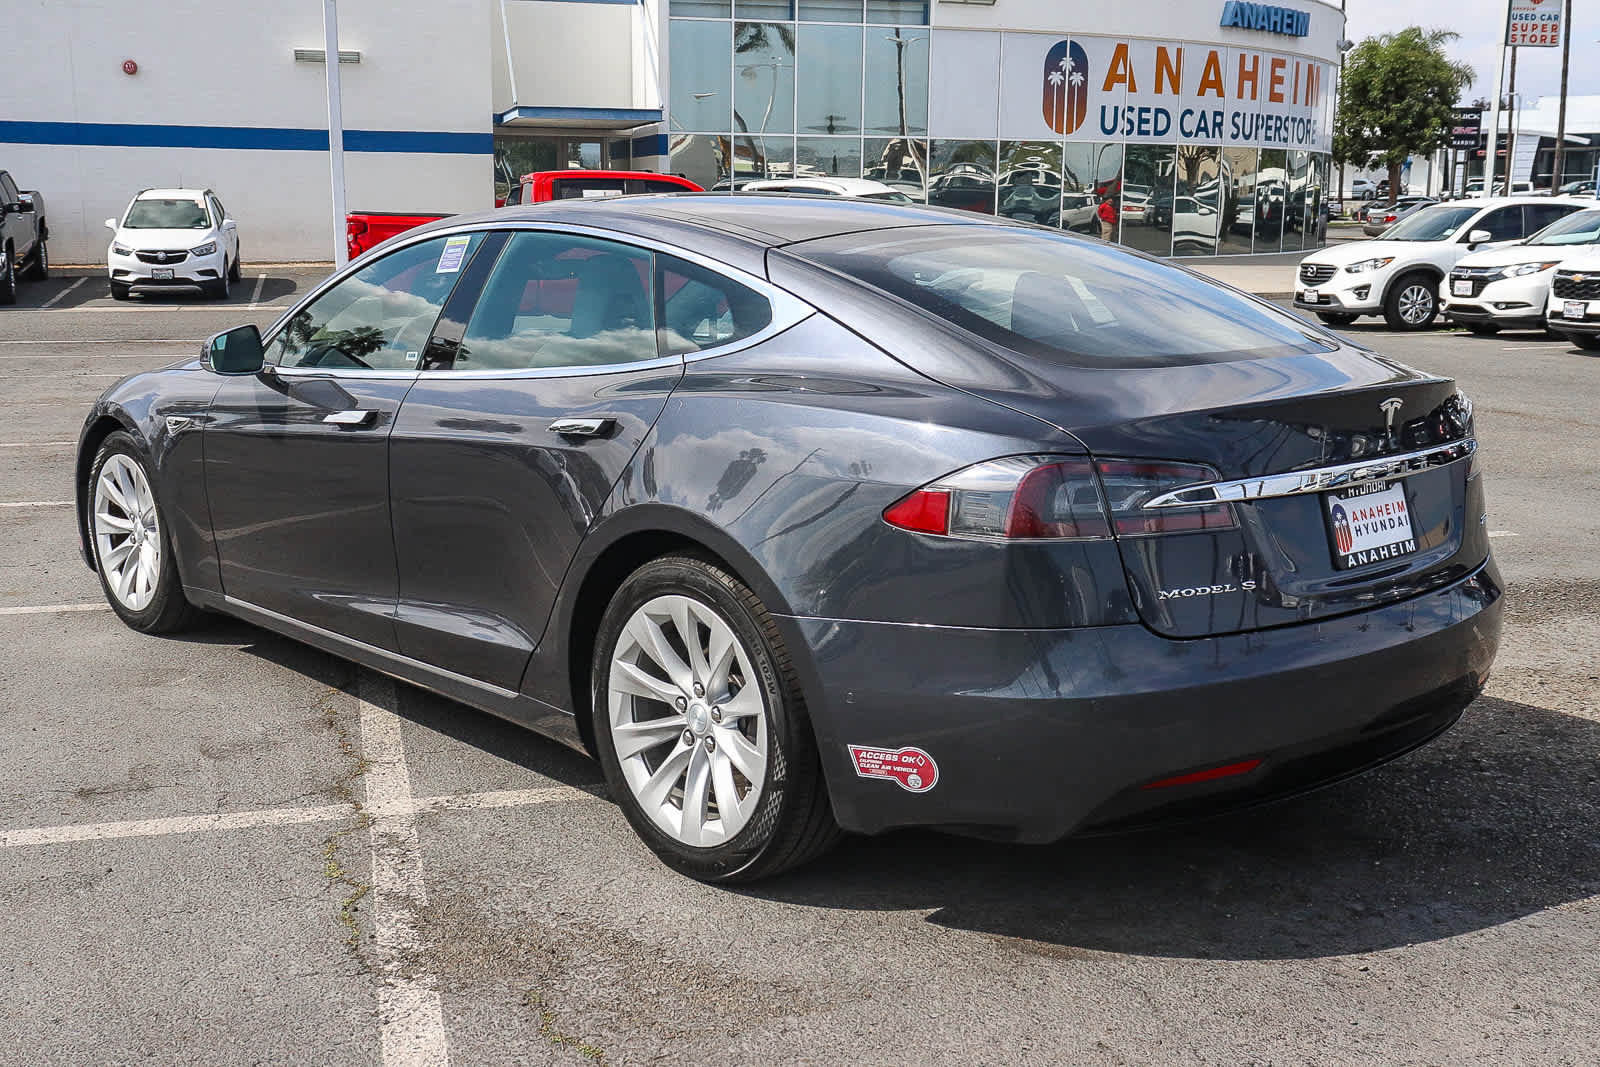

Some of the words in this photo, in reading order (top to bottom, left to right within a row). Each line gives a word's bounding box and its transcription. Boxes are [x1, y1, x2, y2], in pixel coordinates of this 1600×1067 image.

[1220, 0, 1311, 37] ANAHEIM
[1511, 23, 1559, 33] SUPER
[1540, 14, 1559, 22] CAR
[1511, 34, 1558, 43] STORE
[1102, 42, 1321, 107] ANAHEIM
[1101, 104, 1171, 136] USED
[1179, 108, 1224, 139] CAR
[1230, 111, 1317, 145] SUPERSTORE
[1452, 126, 1479, 135] GMC
[1352, 500, 1406, 523] ANAHEIM
[1354, 514, 1409, 538] HYUNDAI
[1348, 540, 1416, 568] ANAHEIM
[1158, 584, 1237, 600] MODEL
[1241, 580, 1257, 591] S
[859, 751, 898, 762] ACCESS
[902, 755, 916, 764] OK
